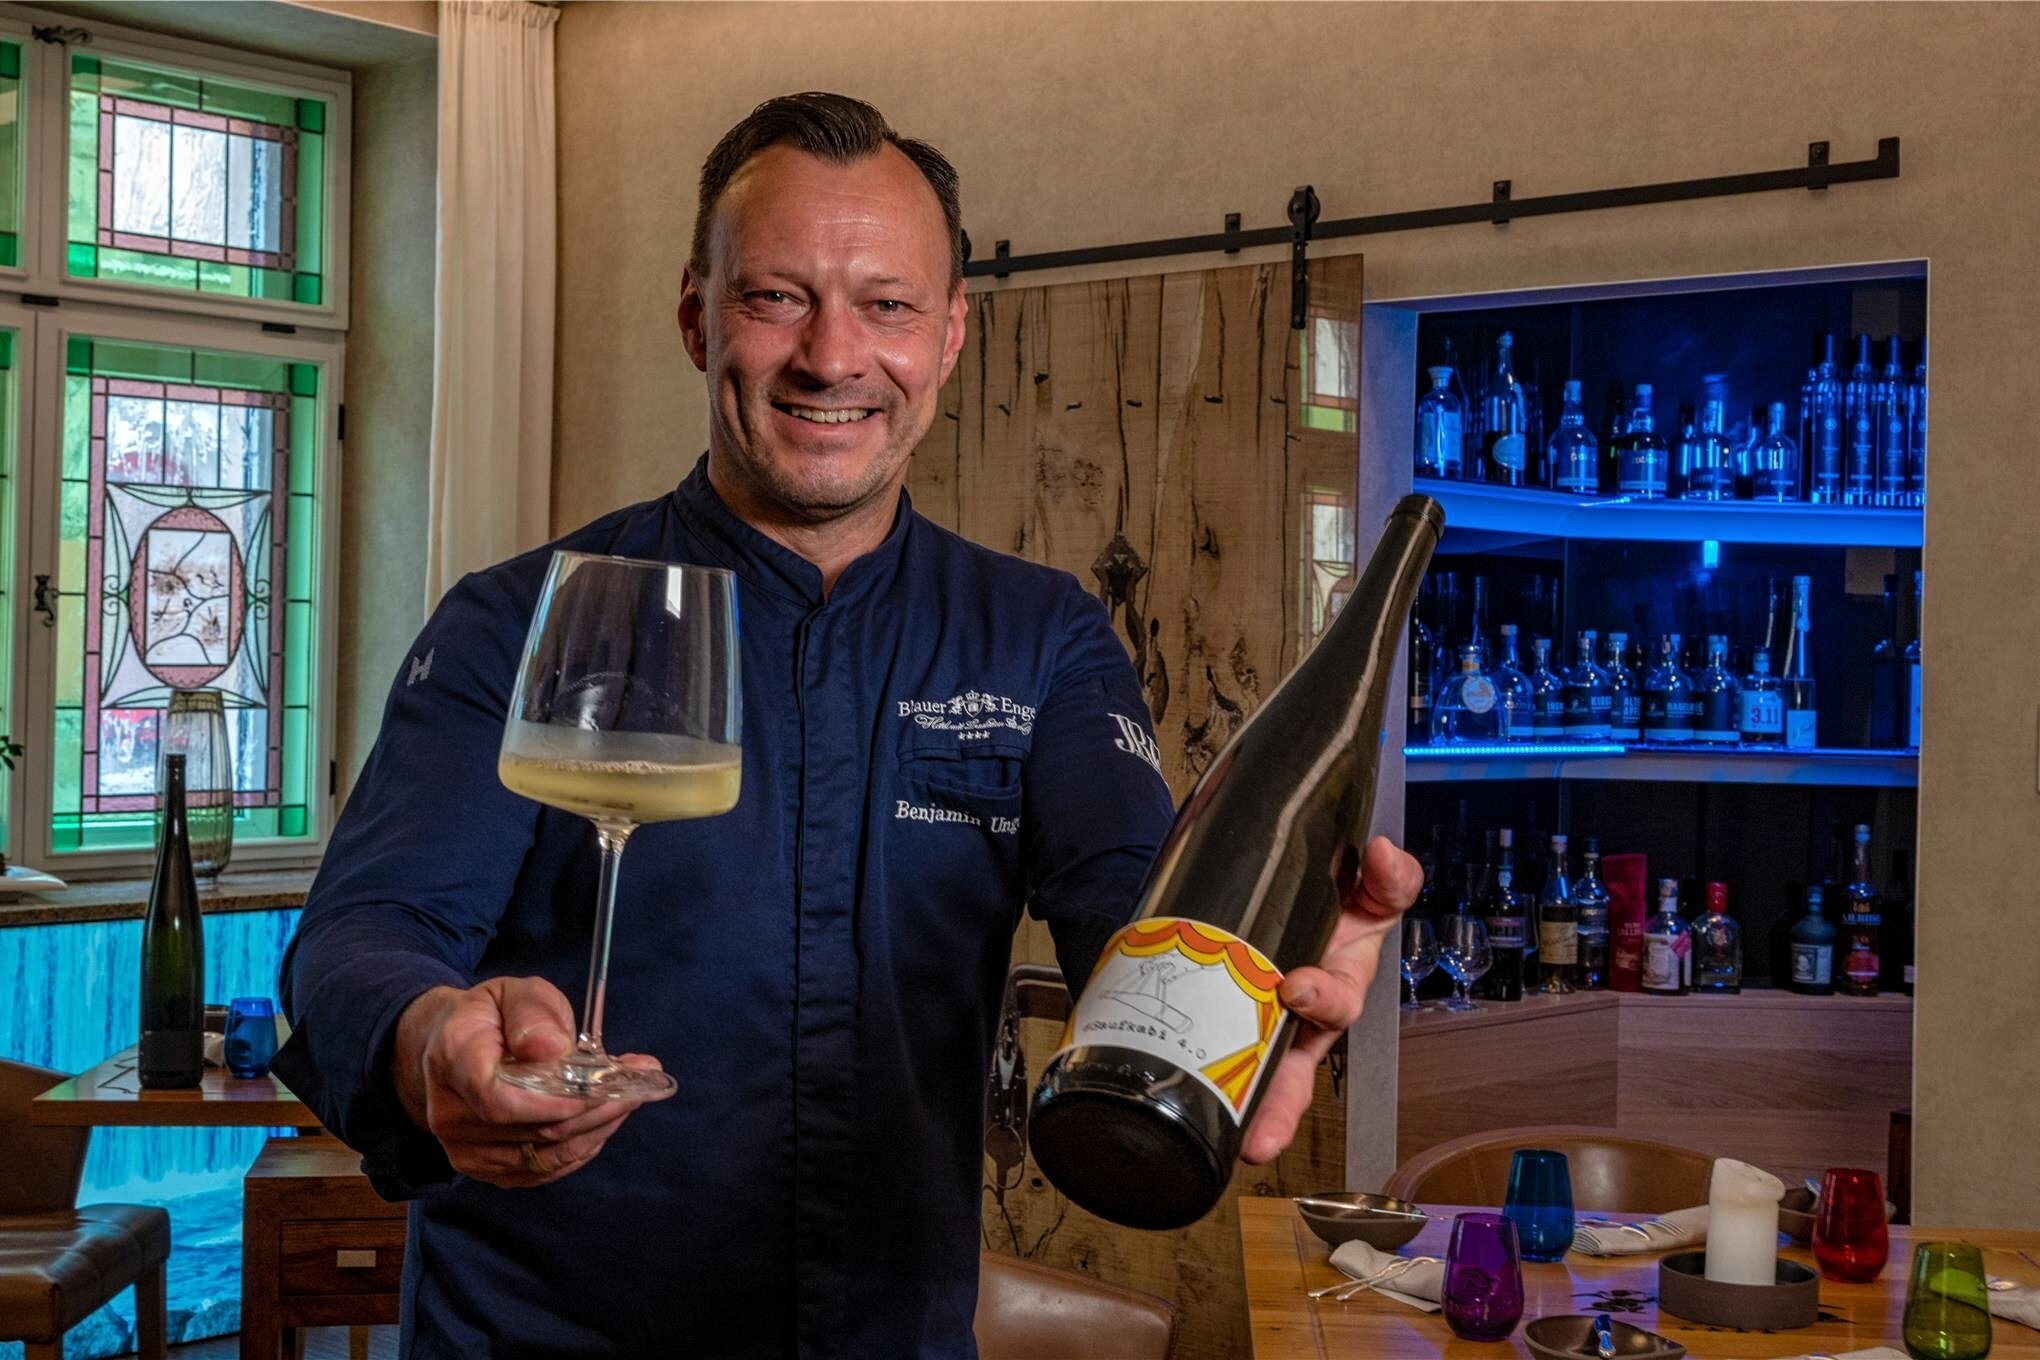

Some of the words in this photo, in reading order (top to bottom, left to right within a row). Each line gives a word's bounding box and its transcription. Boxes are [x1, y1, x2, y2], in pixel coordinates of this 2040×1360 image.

[897, 699, 947, 717] Blauer
[1000, 696, 1037, 721] Enge
[1751, 708, 1779, 724] 3.11
[895, 800, 981, 827] Benjamin
